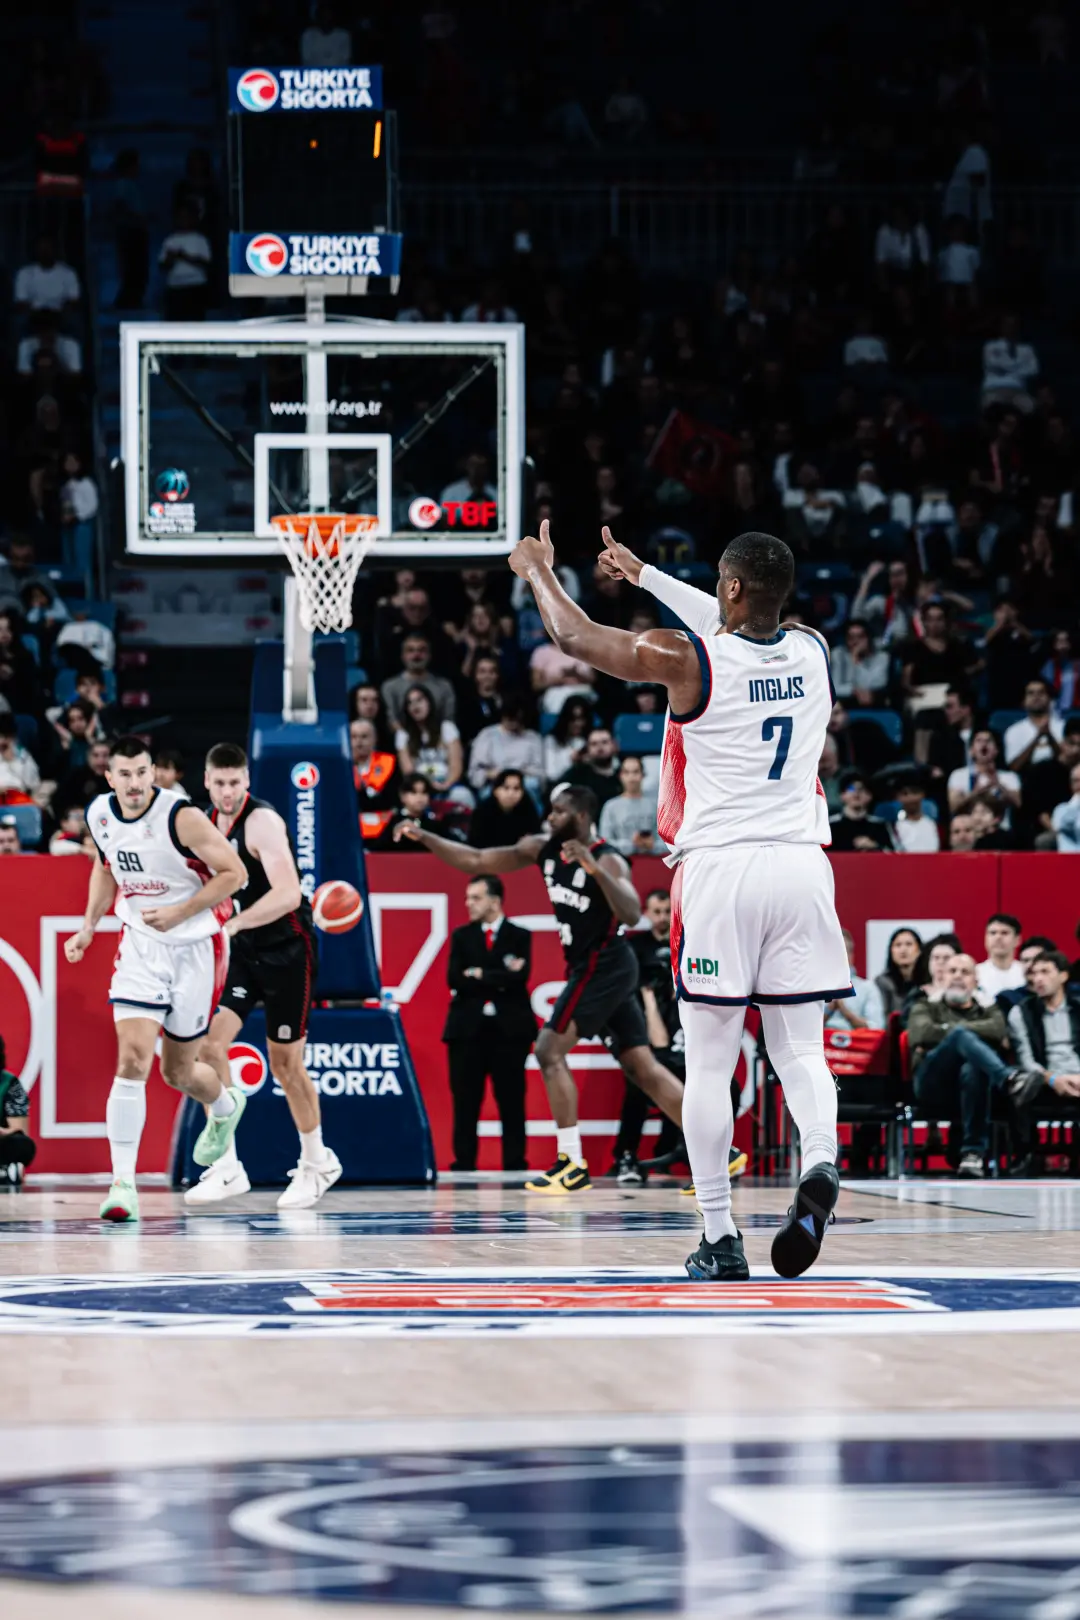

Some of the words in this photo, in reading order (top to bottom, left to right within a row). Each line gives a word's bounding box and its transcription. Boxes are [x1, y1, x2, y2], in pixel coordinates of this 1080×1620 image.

[441, 501, 497, 527] TBF
[748, 675, 805, 702] INGLIS
[761, 716, 793, 780] 7
[117, 850, 144, 872] 99
[687, 957, 719, 977] HDI
[271, 1069, 403, 1096] SGORTA
